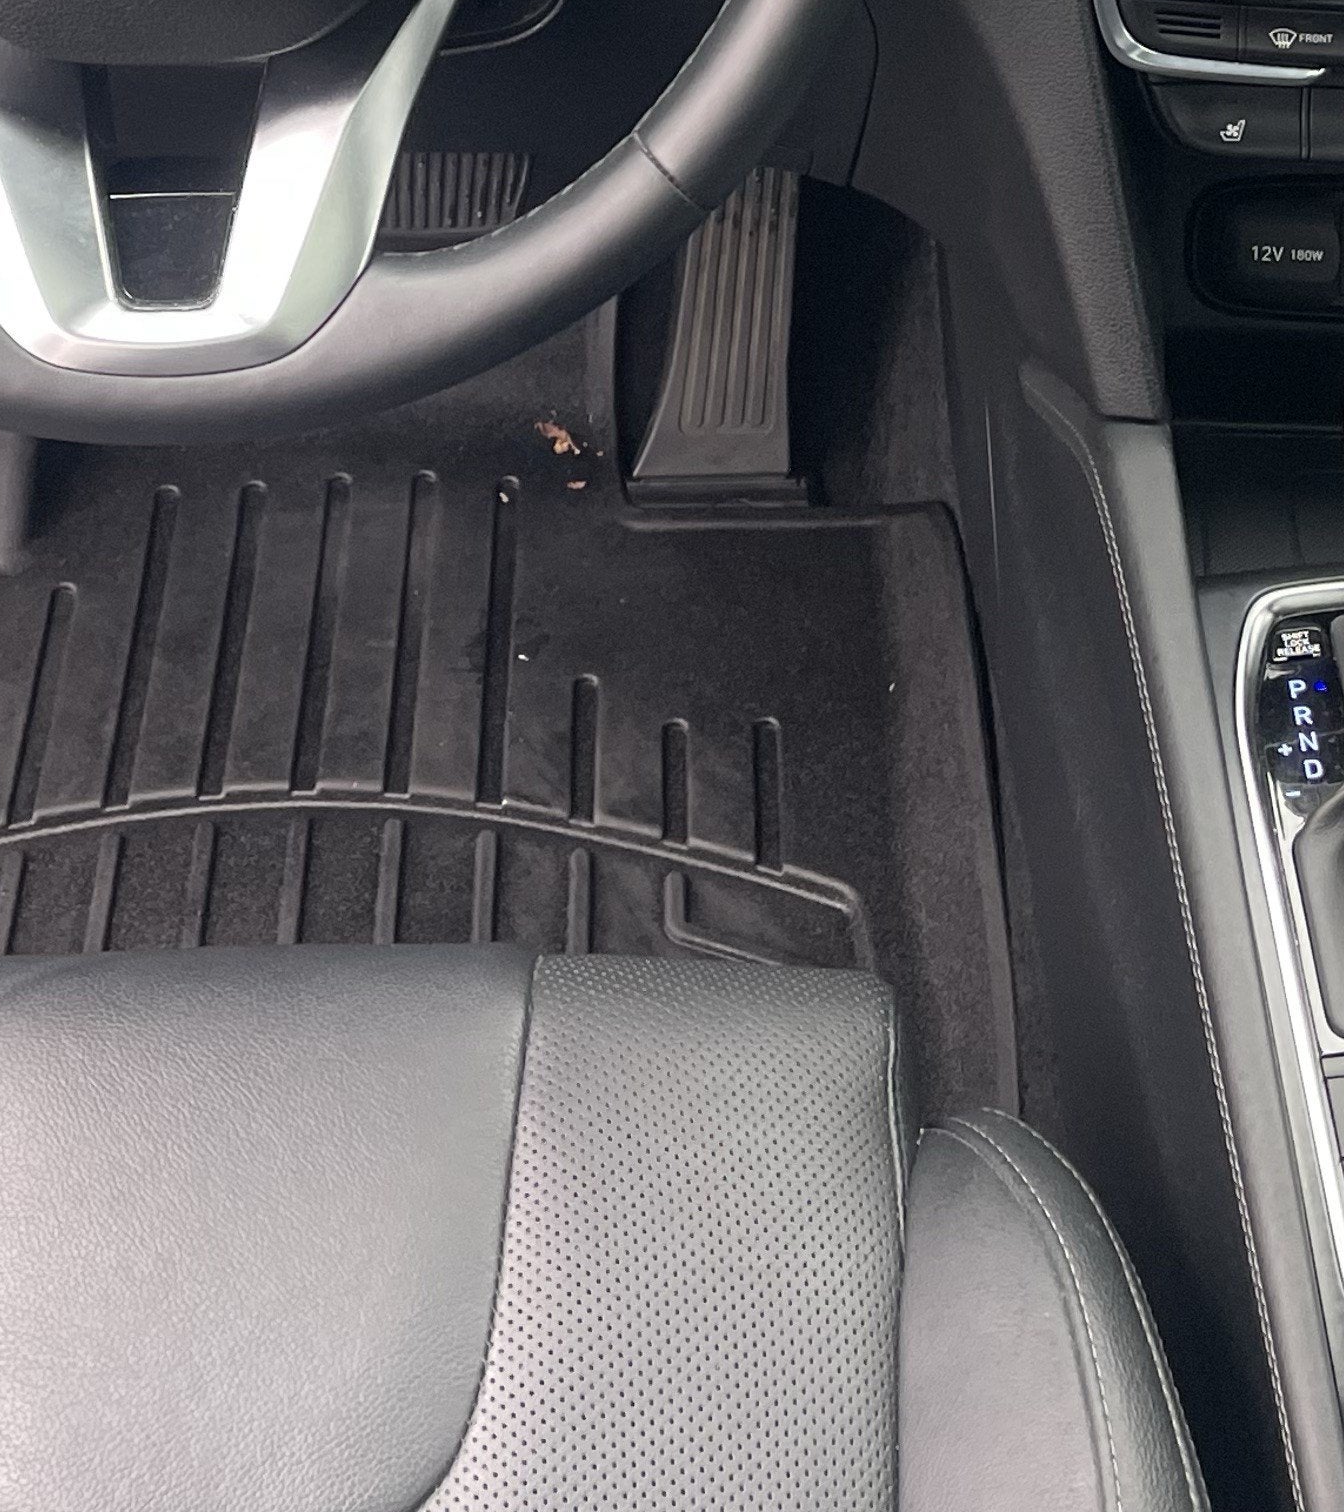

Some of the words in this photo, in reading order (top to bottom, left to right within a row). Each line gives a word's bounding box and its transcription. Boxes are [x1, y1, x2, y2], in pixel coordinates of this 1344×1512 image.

[1298, 33, 1334, 44] FRONT
[1251, 245, 1284, 262] 12V
[1291, 249, 1324, 262] 180W
[1288, 679, 1306, 699] P
[1293, 706, 1313, 726] R
[1298, 731, 1319, 752] N
[1303, 759, 1324, 780] D
